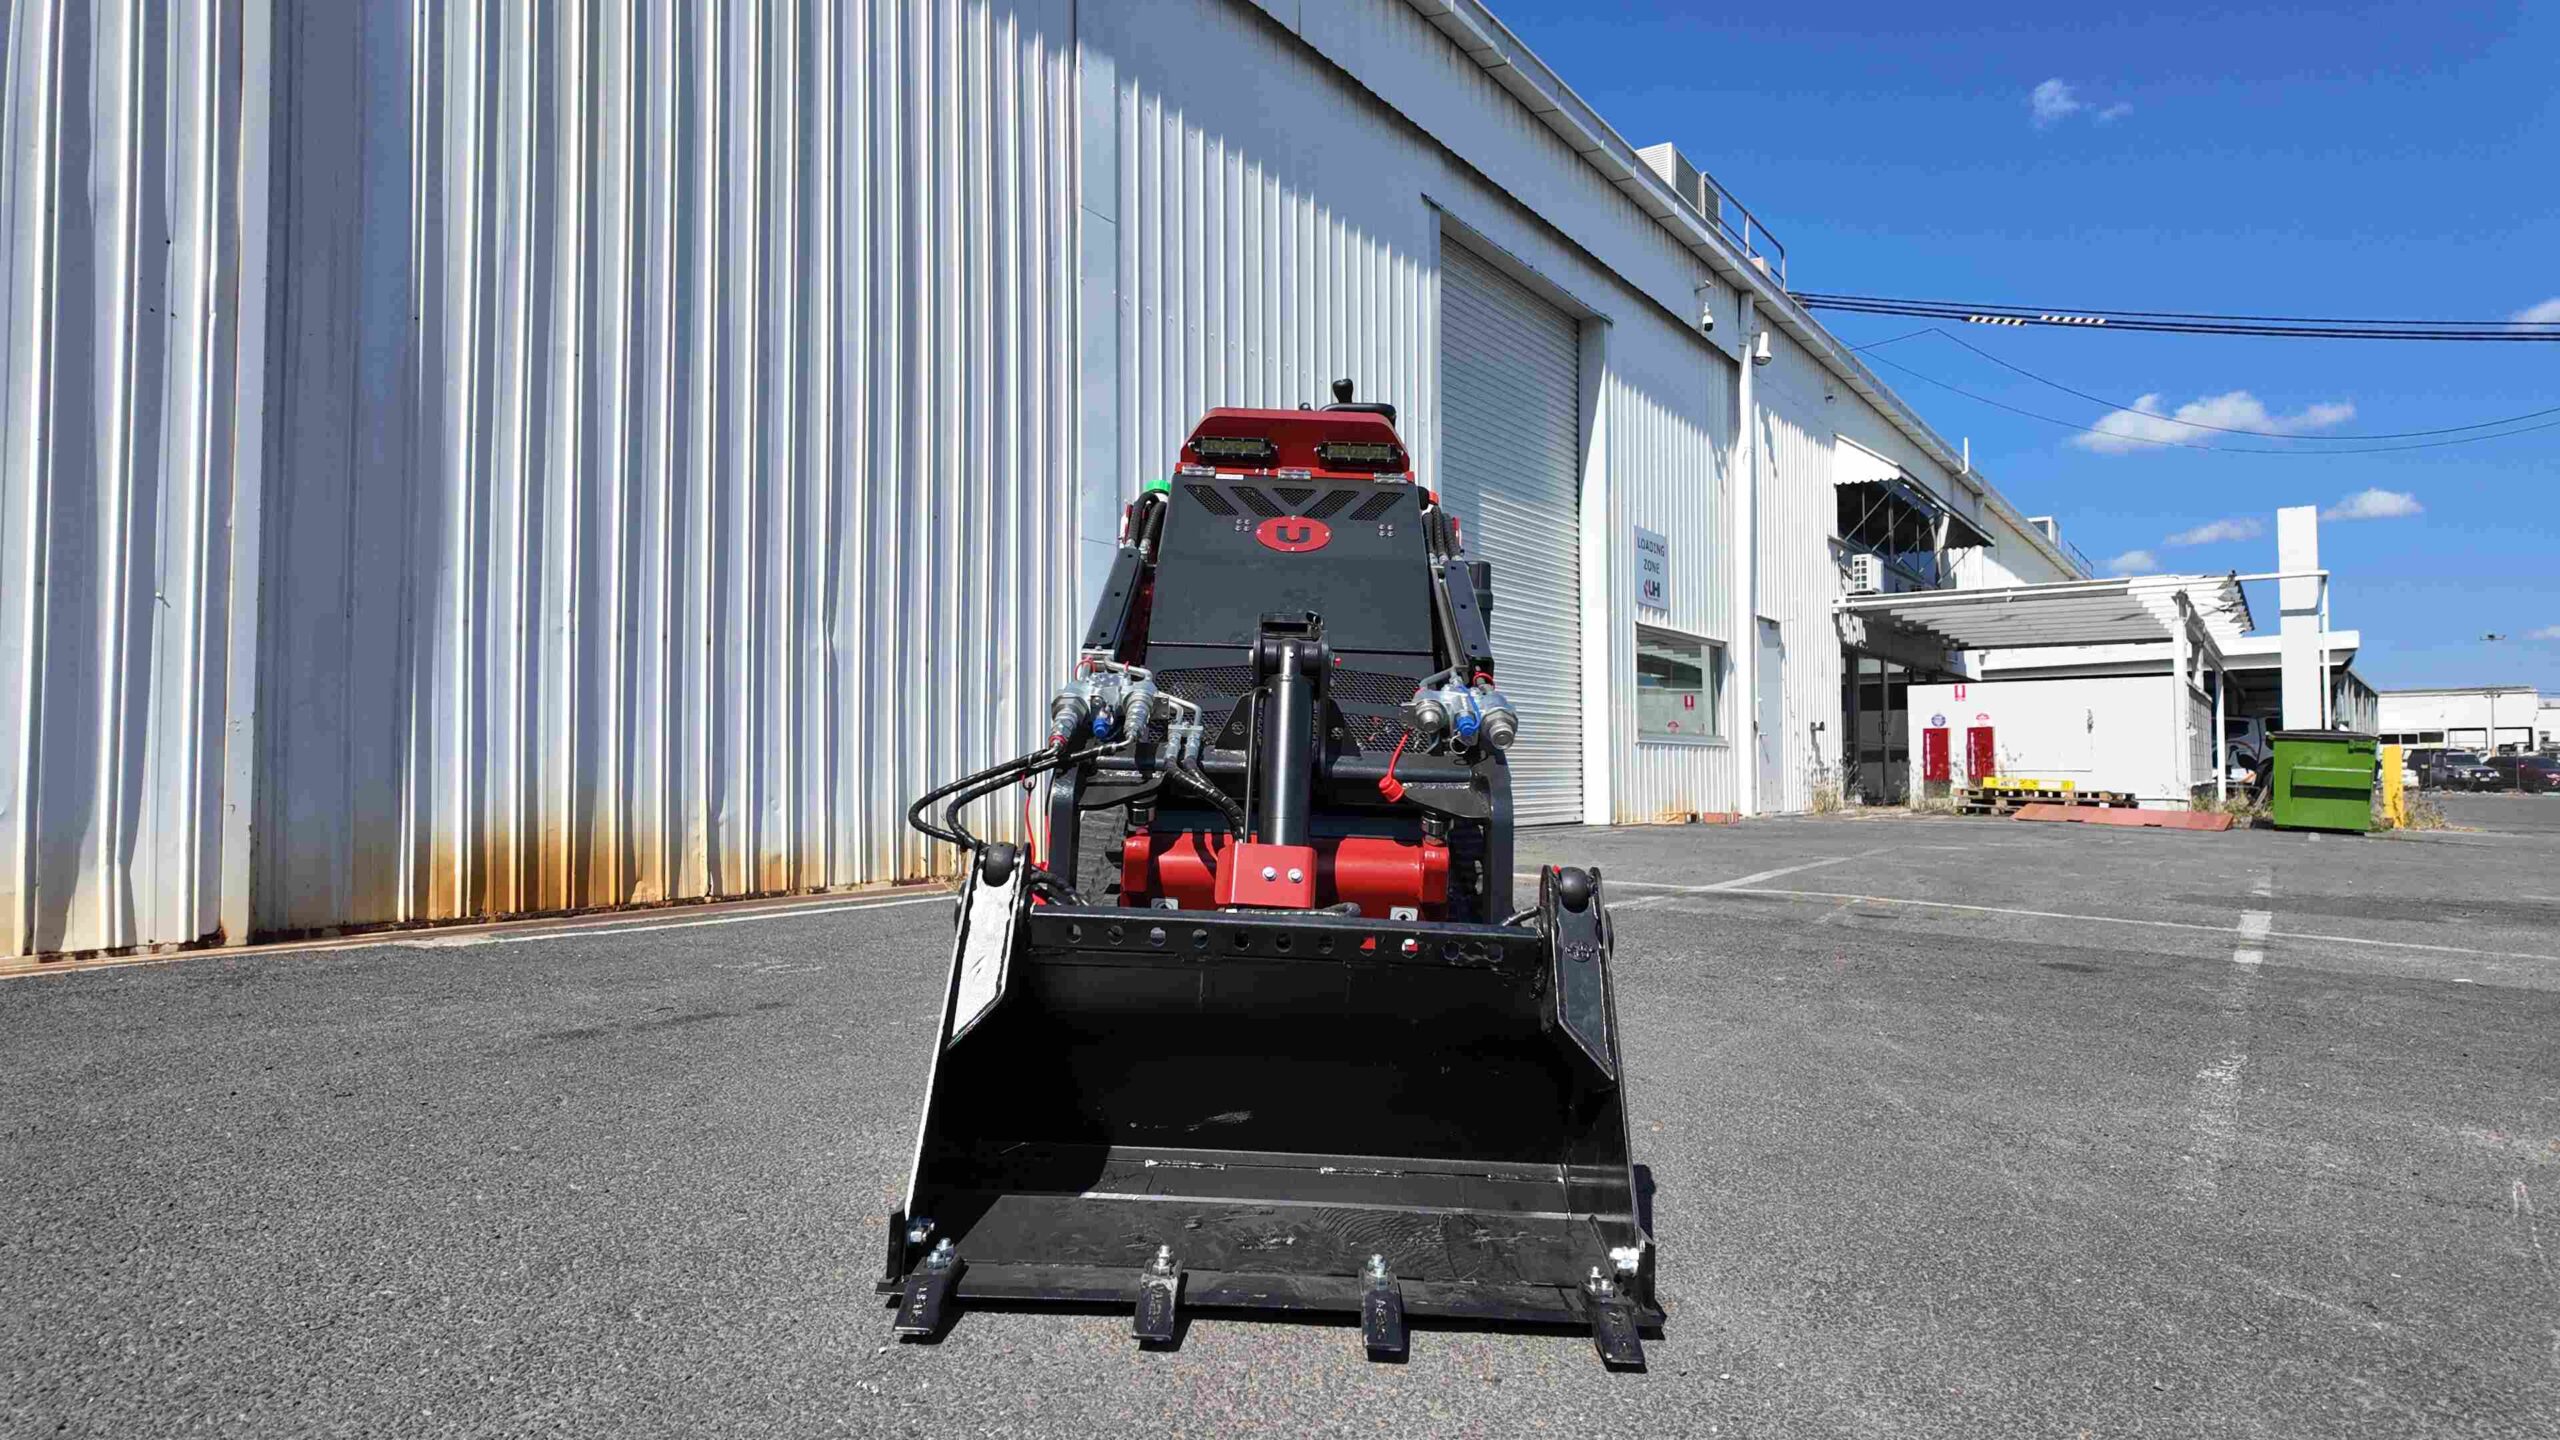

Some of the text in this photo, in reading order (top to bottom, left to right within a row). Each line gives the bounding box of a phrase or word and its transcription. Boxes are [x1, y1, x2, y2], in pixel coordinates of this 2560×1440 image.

[1276, 526, 1311, 543] U
[1637, 537, 1665, 557] LOADING
[1643, 558, 1660, 574] ZONE
